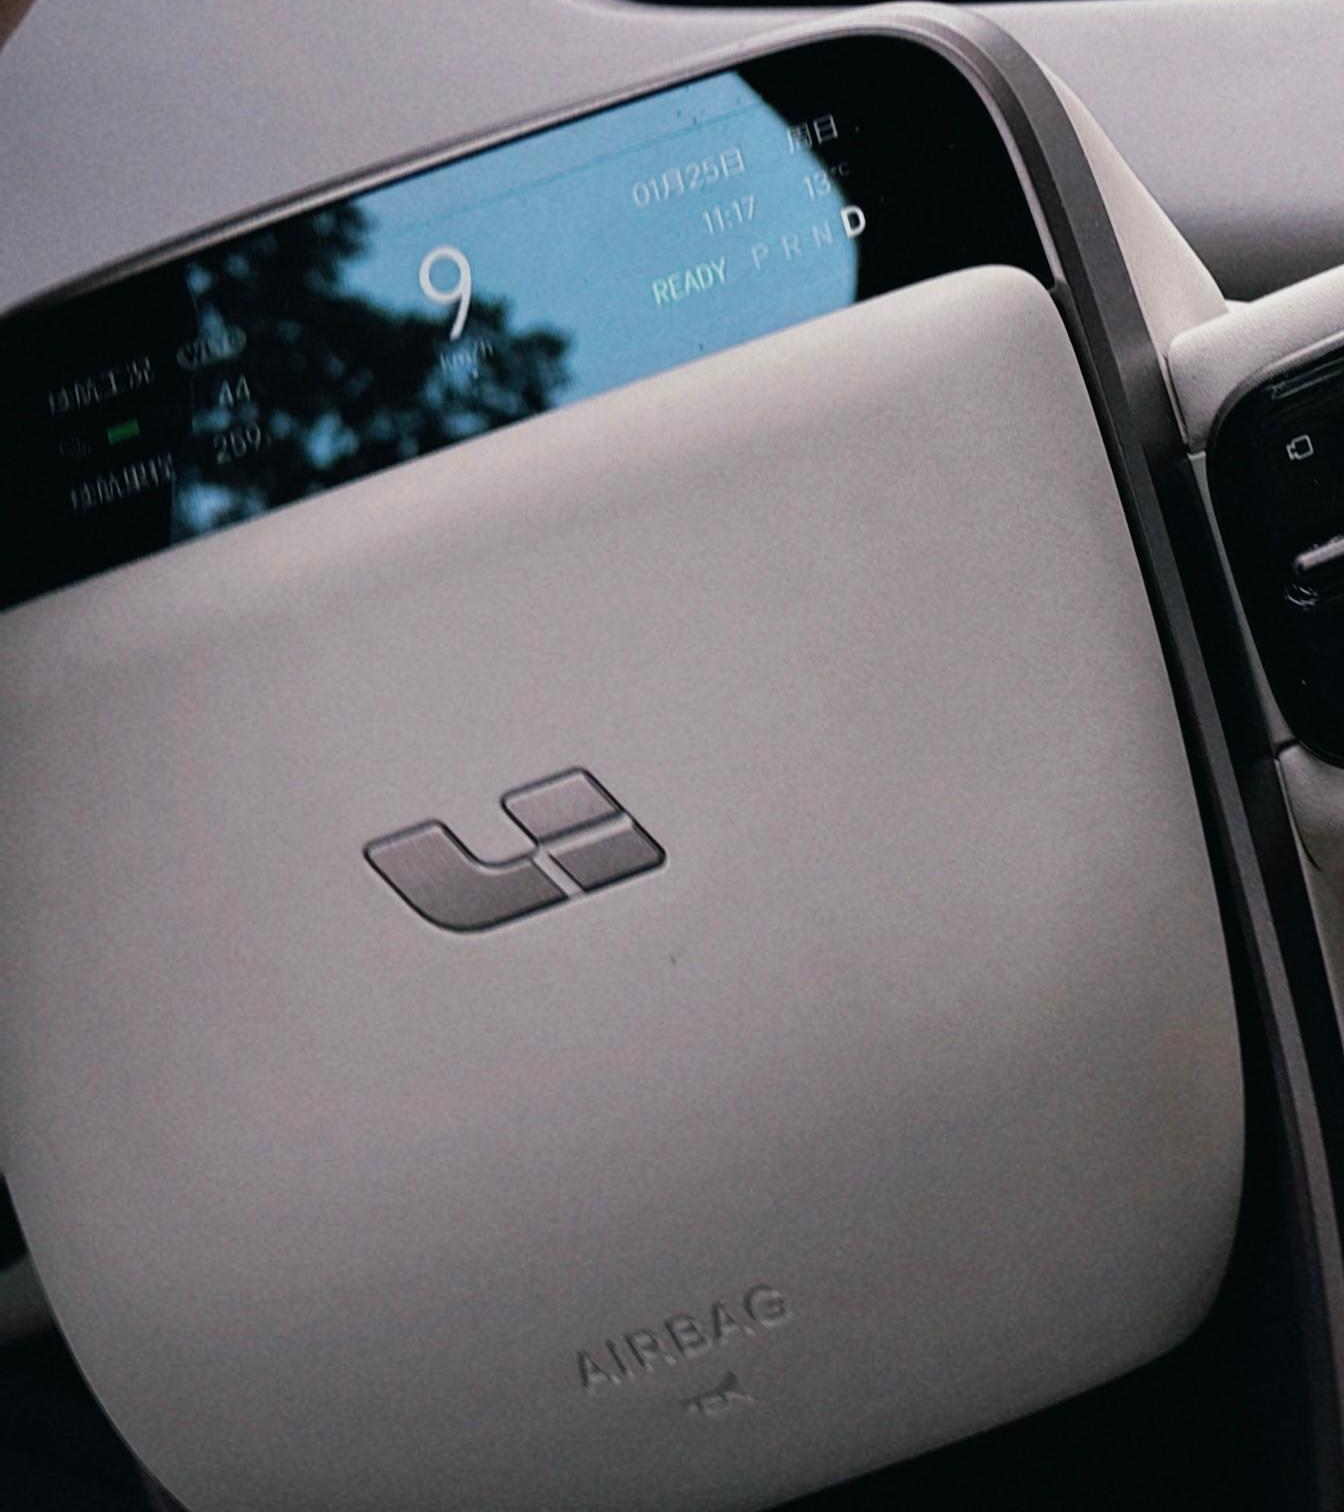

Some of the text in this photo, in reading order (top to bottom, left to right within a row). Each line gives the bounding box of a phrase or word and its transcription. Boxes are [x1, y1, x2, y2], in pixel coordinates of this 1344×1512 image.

[787, 114, 838, 155] 周日
[632, 148, 745, 207] 01月25日
[702, 195, 757, 234] 11:17
[419, 244, 472, 342] 9
[652, 205, 866, 307] READY P R N D
[575, 1283, 796, 1395] AIRBAG
